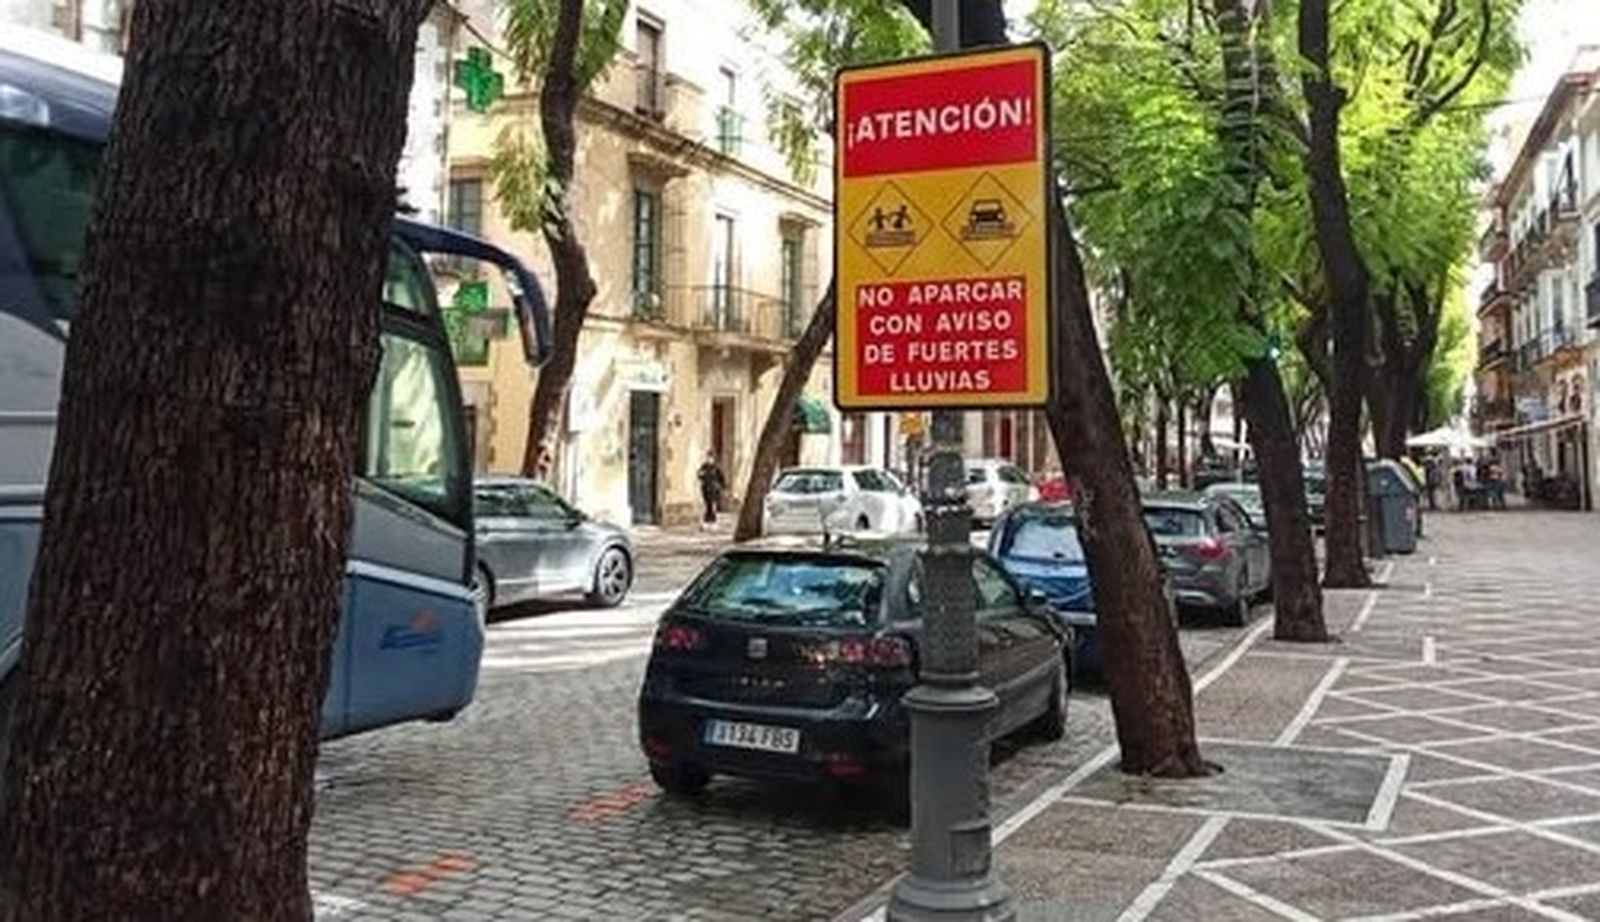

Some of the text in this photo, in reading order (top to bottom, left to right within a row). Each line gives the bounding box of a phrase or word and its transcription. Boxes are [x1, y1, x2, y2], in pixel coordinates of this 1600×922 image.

[847, 96, 1031, 150] ¡ATENCIÓN!
[859, 281, 1022, 307] NO APARCAR
[870, 310, 1011, 336] CON AVISO
[864, 339, 1018, 364] DE FUERTES
[890, 370, 990, 391] LLUVIAS
